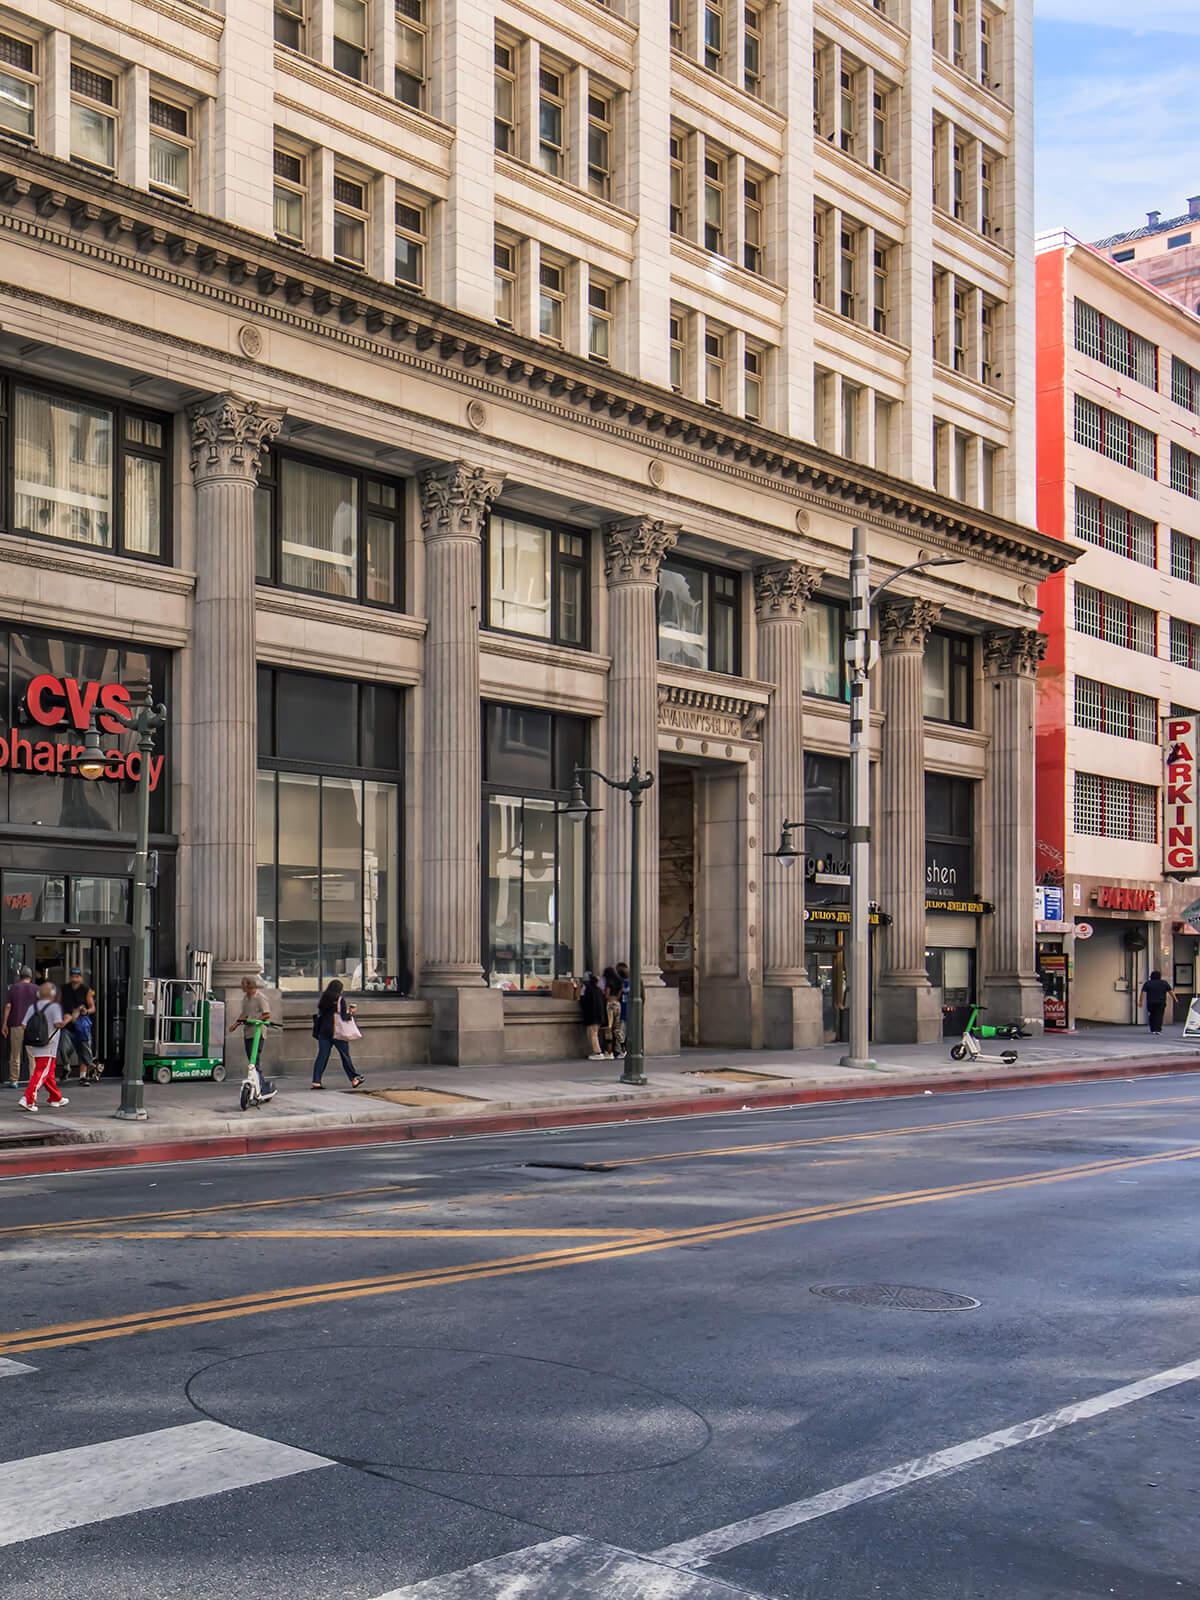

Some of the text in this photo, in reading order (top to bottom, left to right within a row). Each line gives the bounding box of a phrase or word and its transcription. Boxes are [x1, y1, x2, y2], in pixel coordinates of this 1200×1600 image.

[26, 673, 133, 735] CVS
[1167, 720, 1194, 868] PARKING
[926, 859, 957, 884] shen
[1098, 885, 1156, 912] PARKING
[810, 911, 836, 921] JULIO'S
